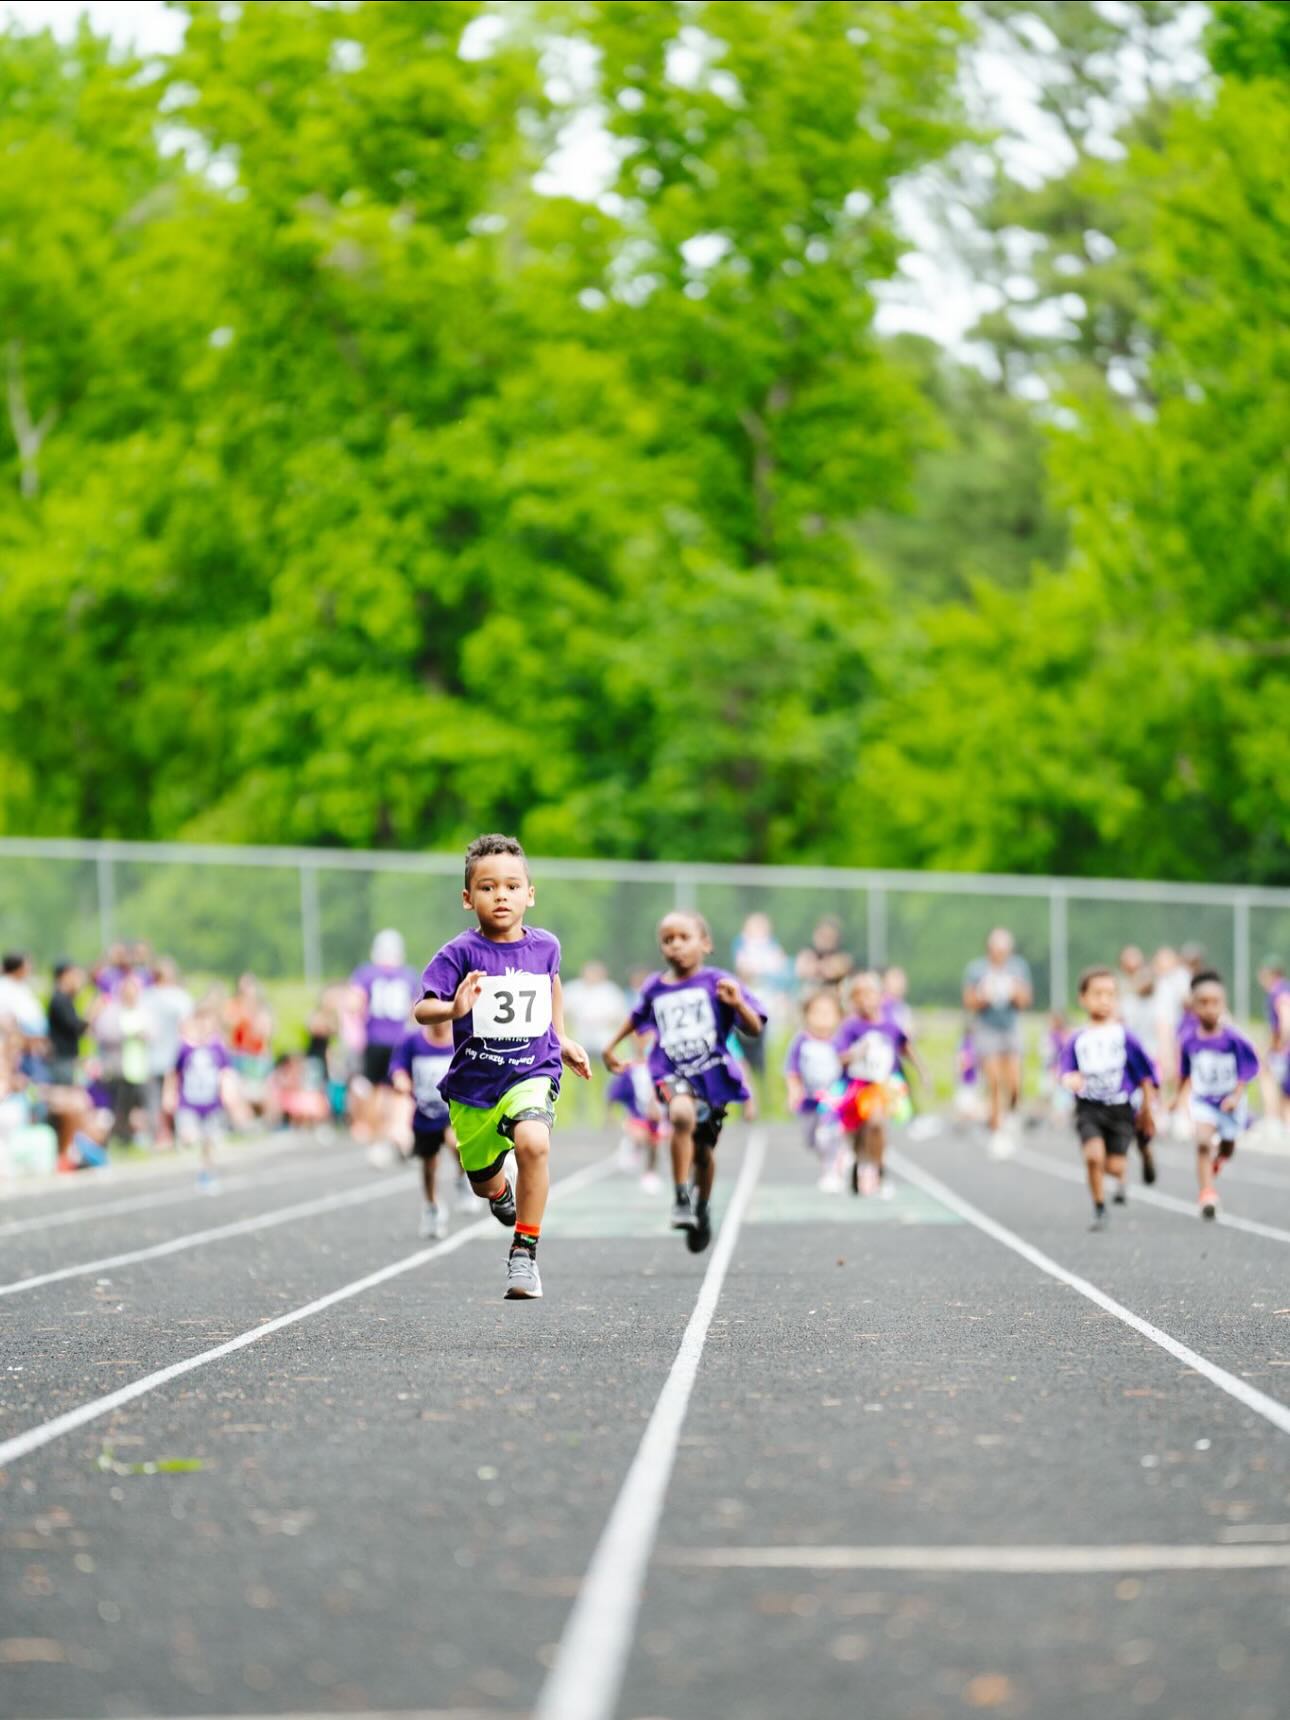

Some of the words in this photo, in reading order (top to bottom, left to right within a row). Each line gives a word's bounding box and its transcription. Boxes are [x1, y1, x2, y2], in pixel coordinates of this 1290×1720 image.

[493, 990, 537, 1024] 37
[658, 999, 705, 1032] 127
[465, 1048, 477, 1060] My
